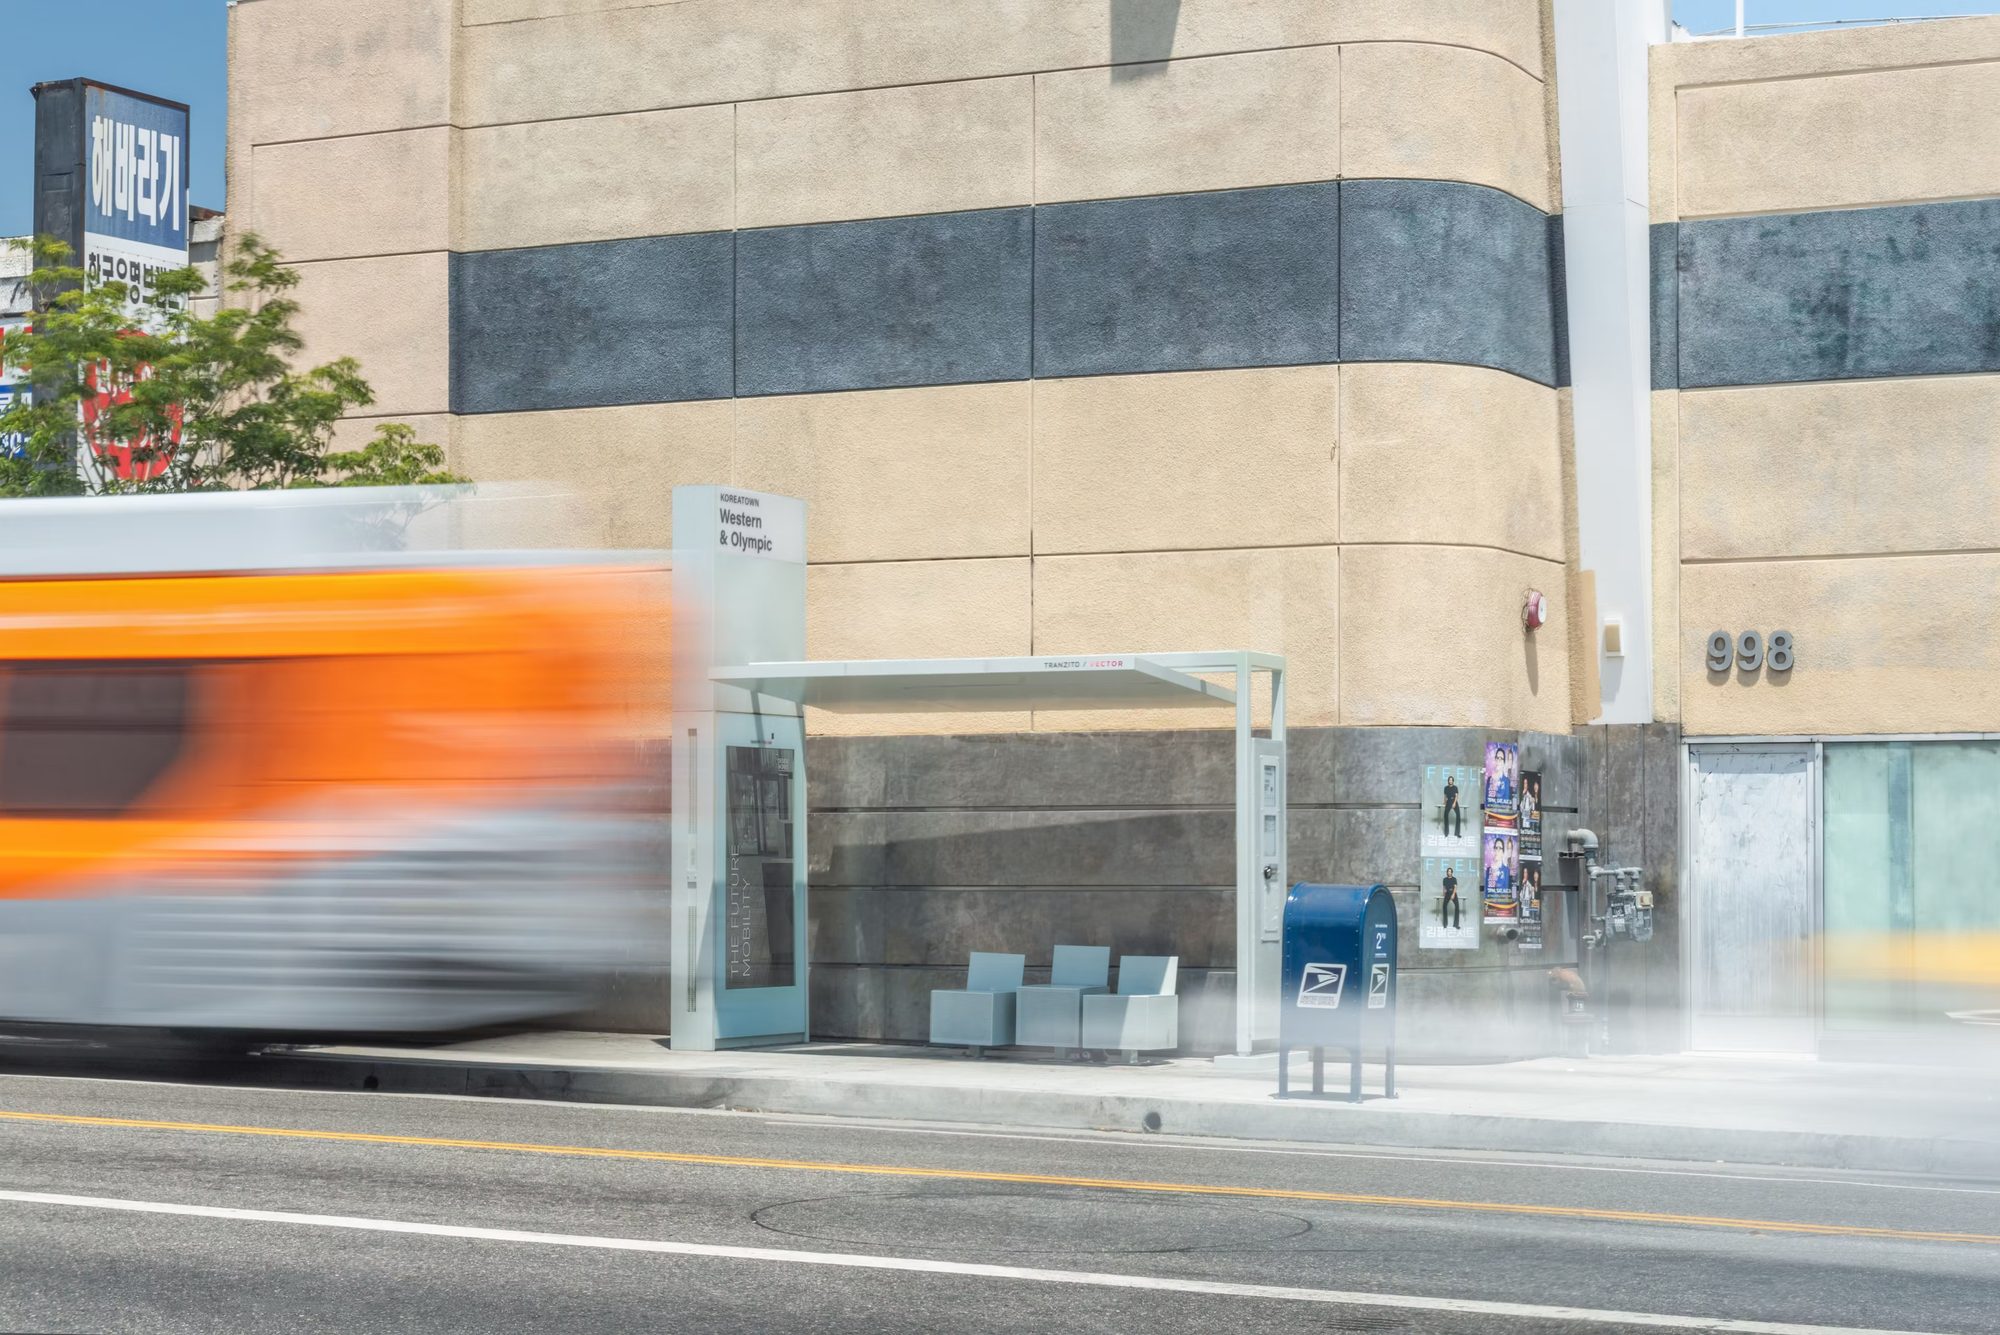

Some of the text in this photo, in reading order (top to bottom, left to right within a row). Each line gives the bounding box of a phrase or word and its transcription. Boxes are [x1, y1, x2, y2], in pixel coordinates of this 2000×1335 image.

[92, 115, 179, 231] 해바라기
[720, 493, 760, 507] KOREATOWN
[720, 508, 762, 529] Western
[720, 530, 773, 553] & Olympic
[1707, 630, 1794, 672] 998
[1044, 661, 1081, 669] TRANZITO
[1427, 766, 1477, 781] FEEL
[1425, 858, 1476, 872] FEEL
[731, 844, 740, 977] THE FUTURE
[742, 878, 751, 977] MOBILITY
